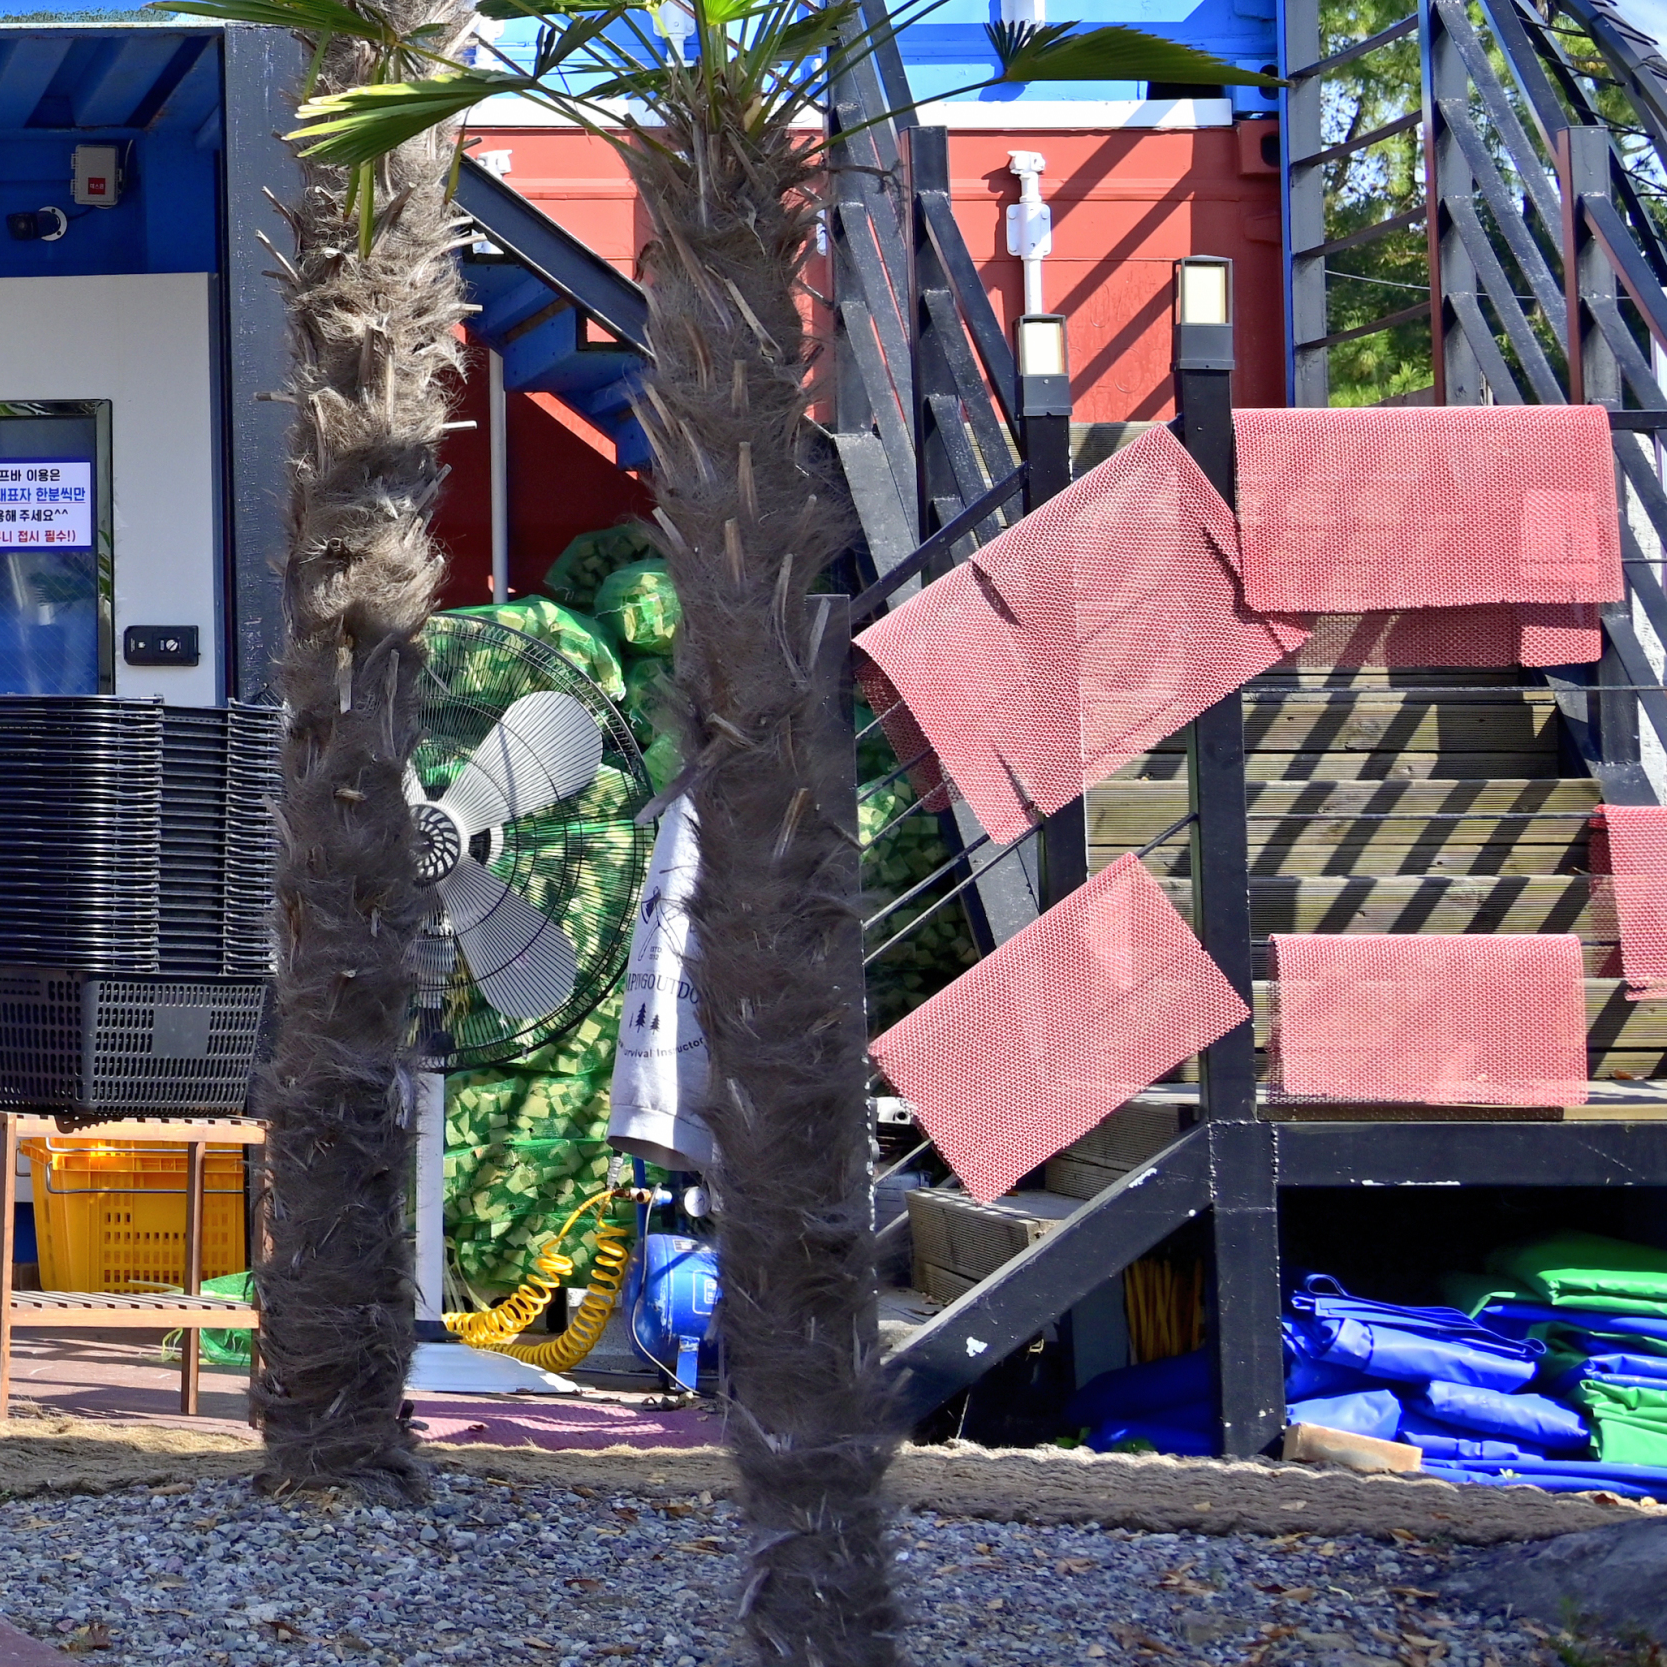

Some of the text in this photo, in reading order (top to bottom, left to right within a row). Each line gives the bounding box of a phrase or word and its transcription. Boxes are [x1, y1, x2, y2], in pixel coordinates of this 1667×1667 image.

[26, 468, 61, 482] 이용은
[36, 487, 86, 502] 한분씩만
[18, 530, 39, 543] 접시
[44, 530, 76, 543] 필수!)
